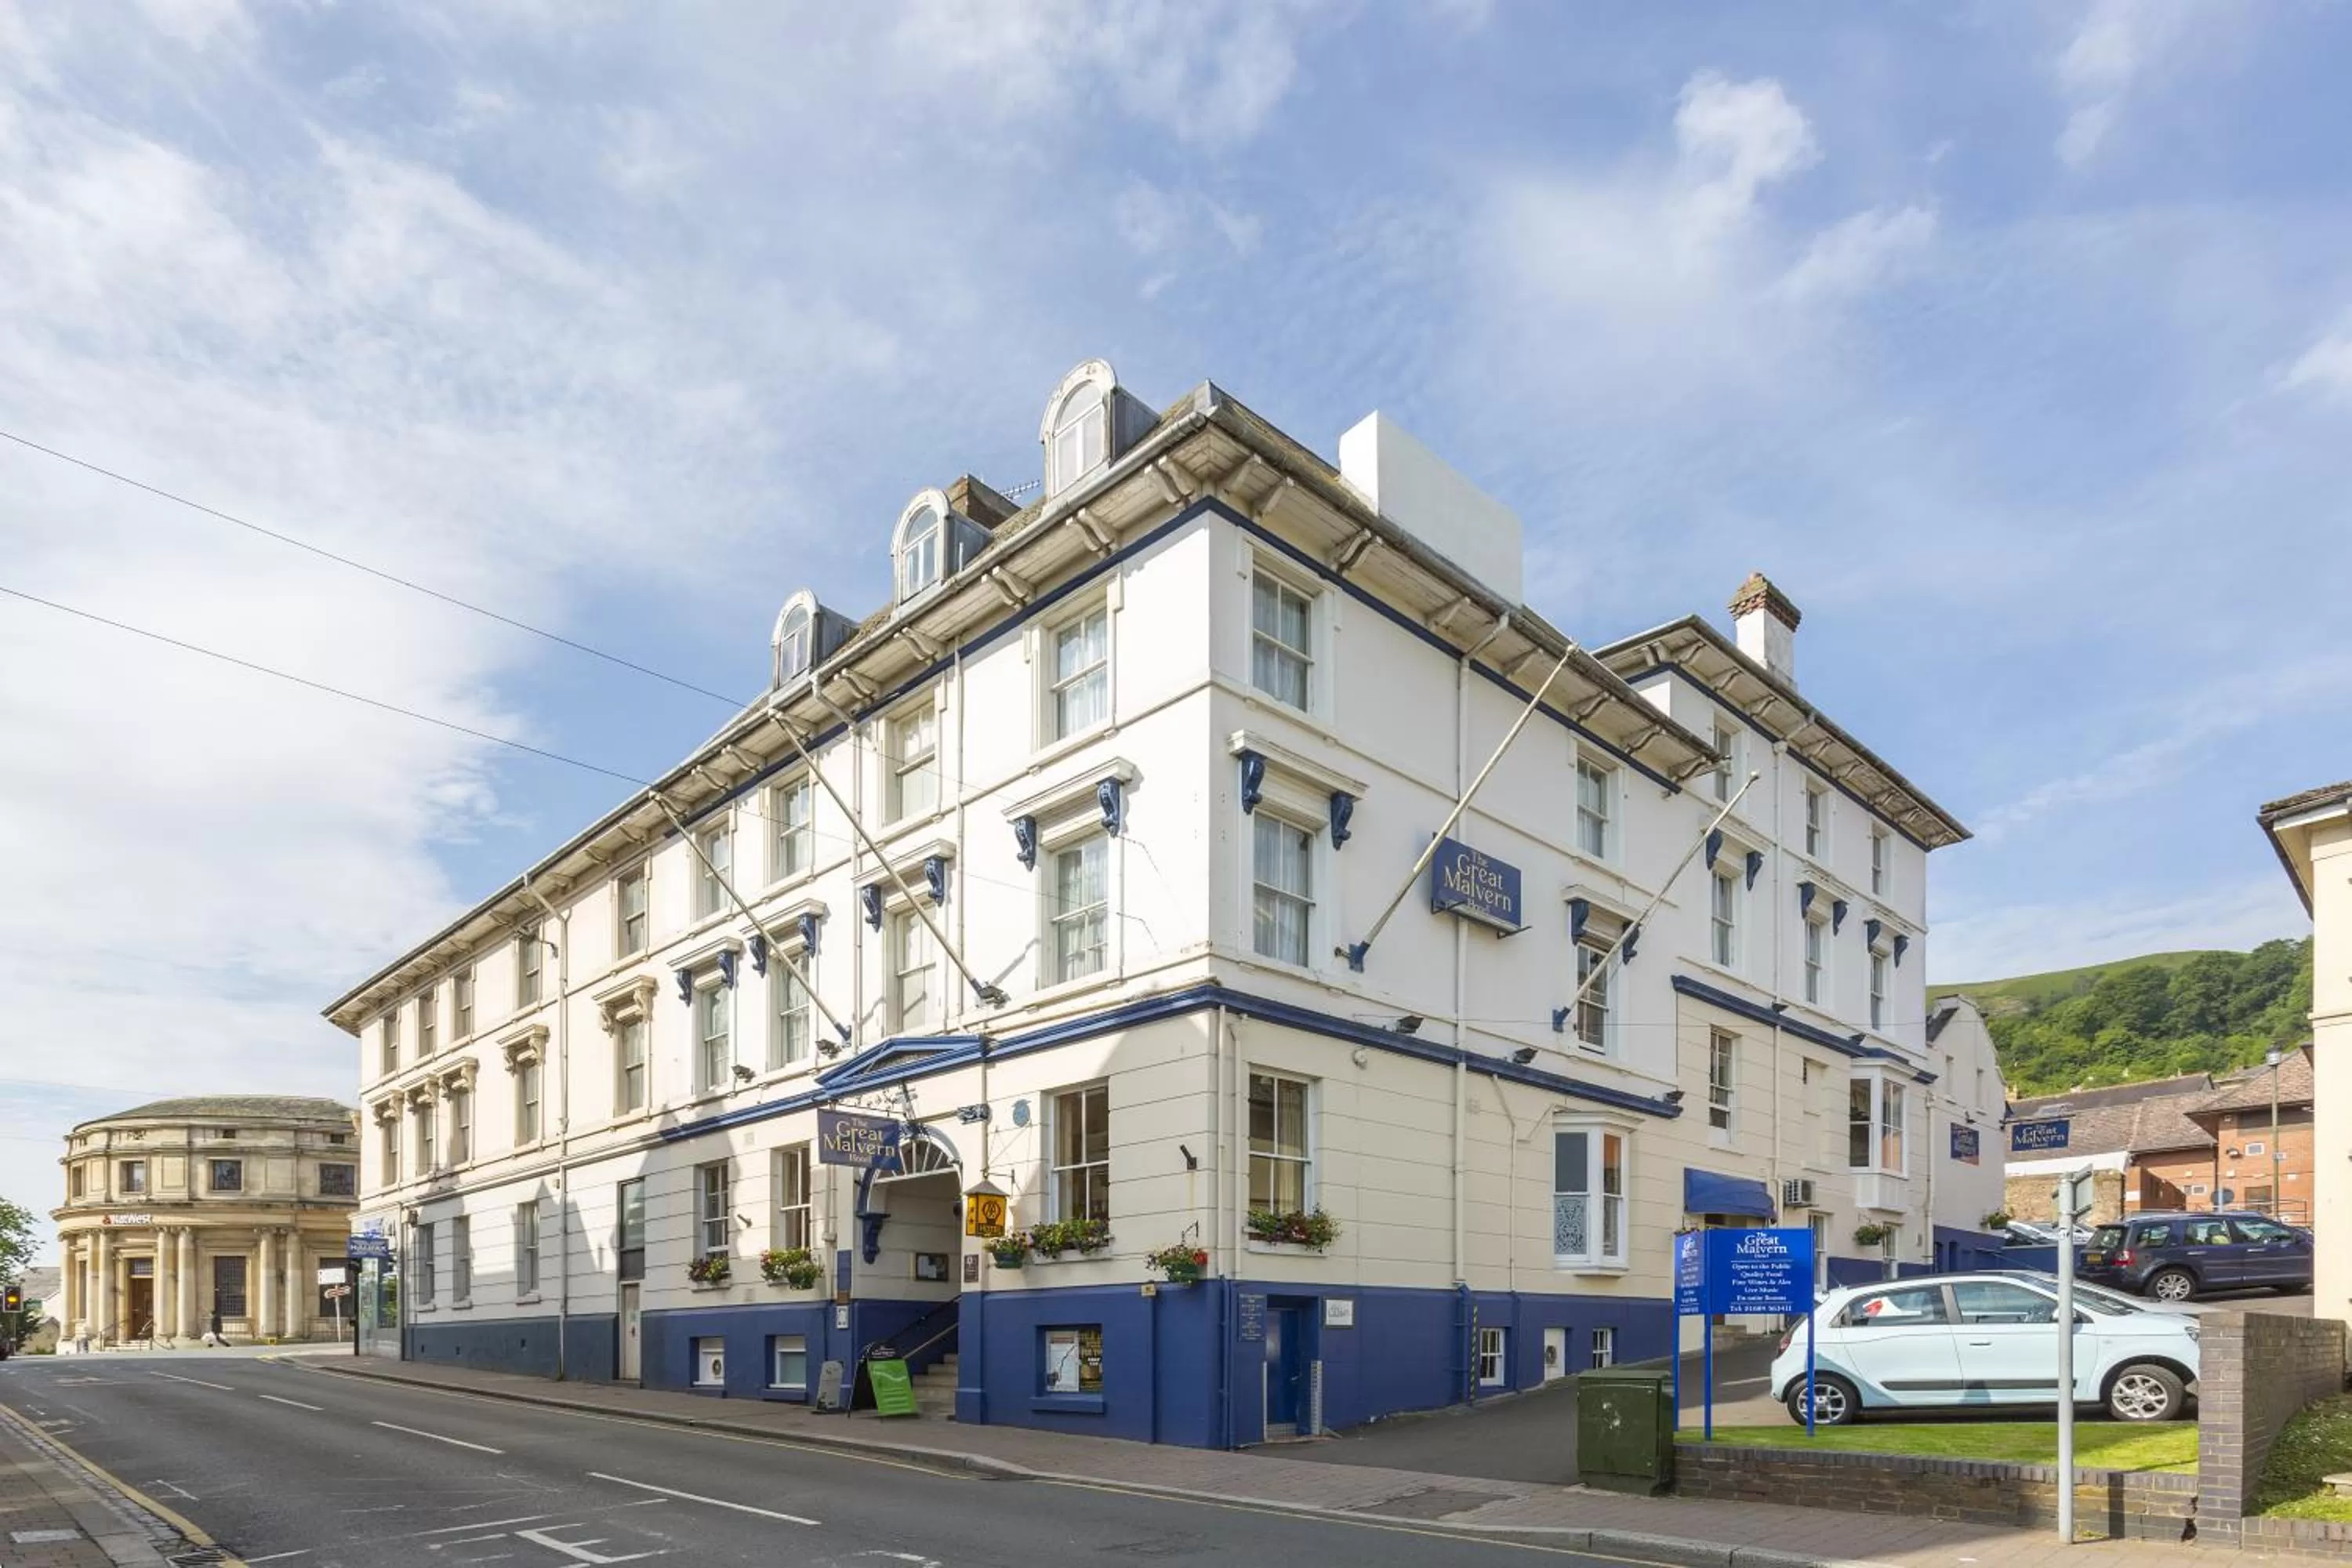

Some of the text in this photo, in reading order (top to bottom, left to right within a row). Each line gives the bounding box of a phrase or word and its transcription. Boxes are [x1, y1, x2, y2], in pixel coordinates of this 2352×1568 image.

[1457, 854, 1503, 891] Great
[1444, 865, 1512, 913] Malvern
[837, 1121, 883, 1142] Great
[2015, 1134, 2065, 1145] Malvern
[824, 1134, 895, 1156] Malvern
[112, 1214, 151, 1224] NatWest
[1736, 1243, 1788, 1253] Malvern
[1744, 1235, 1780, 1245] Great
